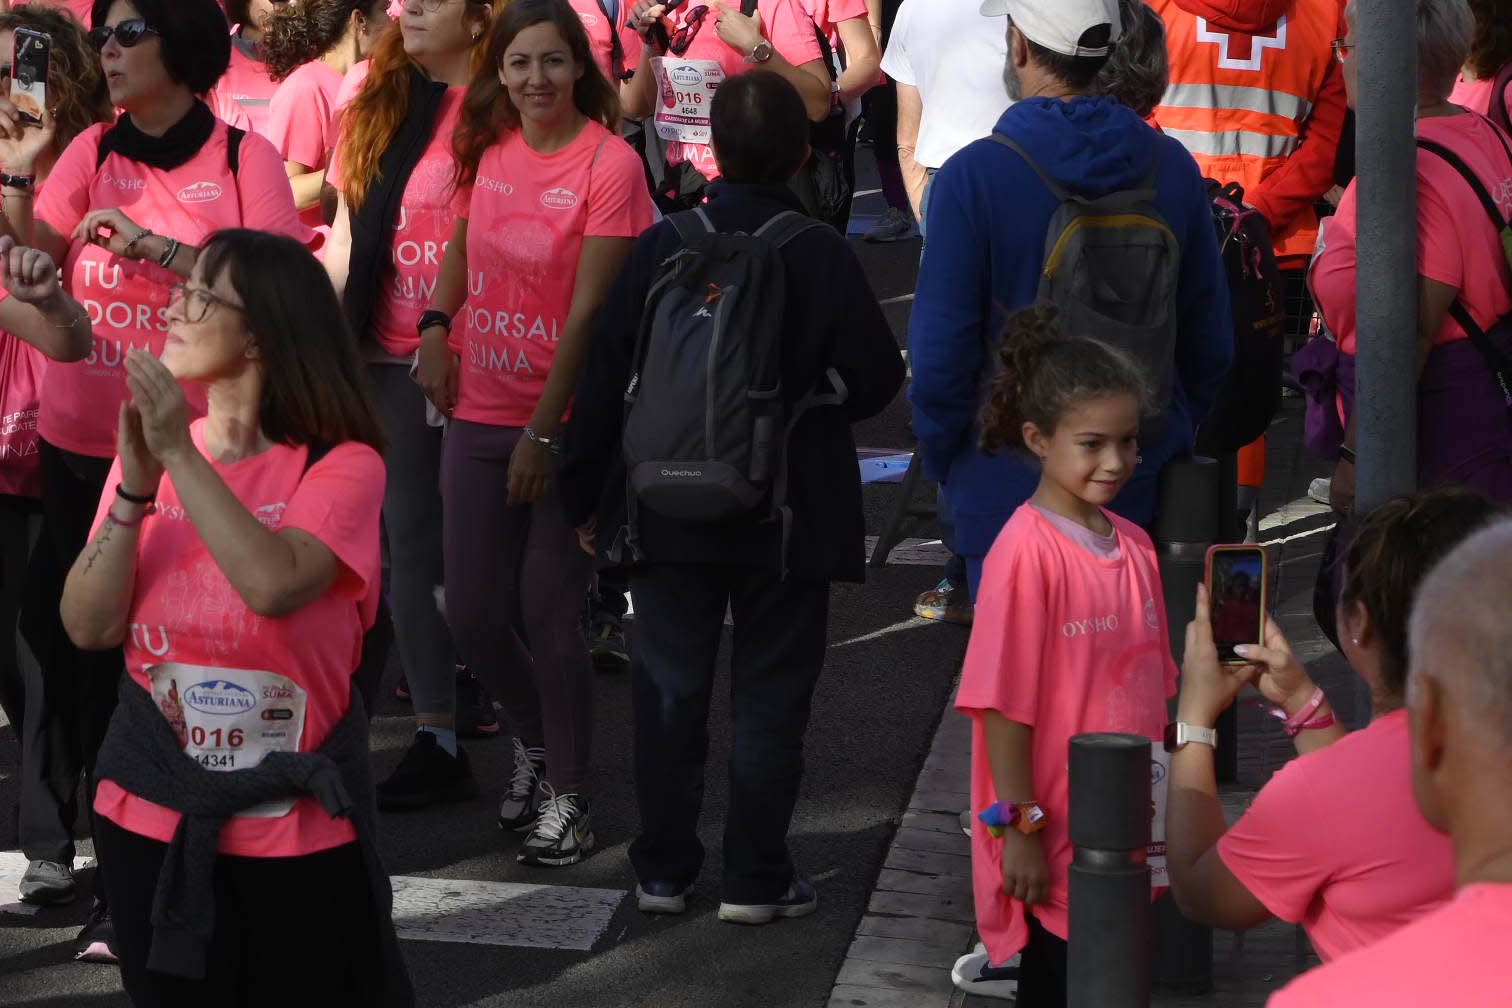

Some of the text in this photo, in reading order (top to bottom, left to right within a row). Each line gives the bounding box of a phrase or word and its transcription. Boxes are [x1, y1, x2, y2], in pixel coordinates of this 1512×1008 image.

[676, 91, 702, 104] 016
[81, 259, 120, 290] TU
[468, 305, 560, 342] DORSAL
[469, 341, 534, 373] SUMA
[661, 468, 702, 477] Quechua
[1063, 613, 1119, 638] OYSHO
[188, 691, 251, 708] ASTURIANA
[191, 726, 245, 748] 016
